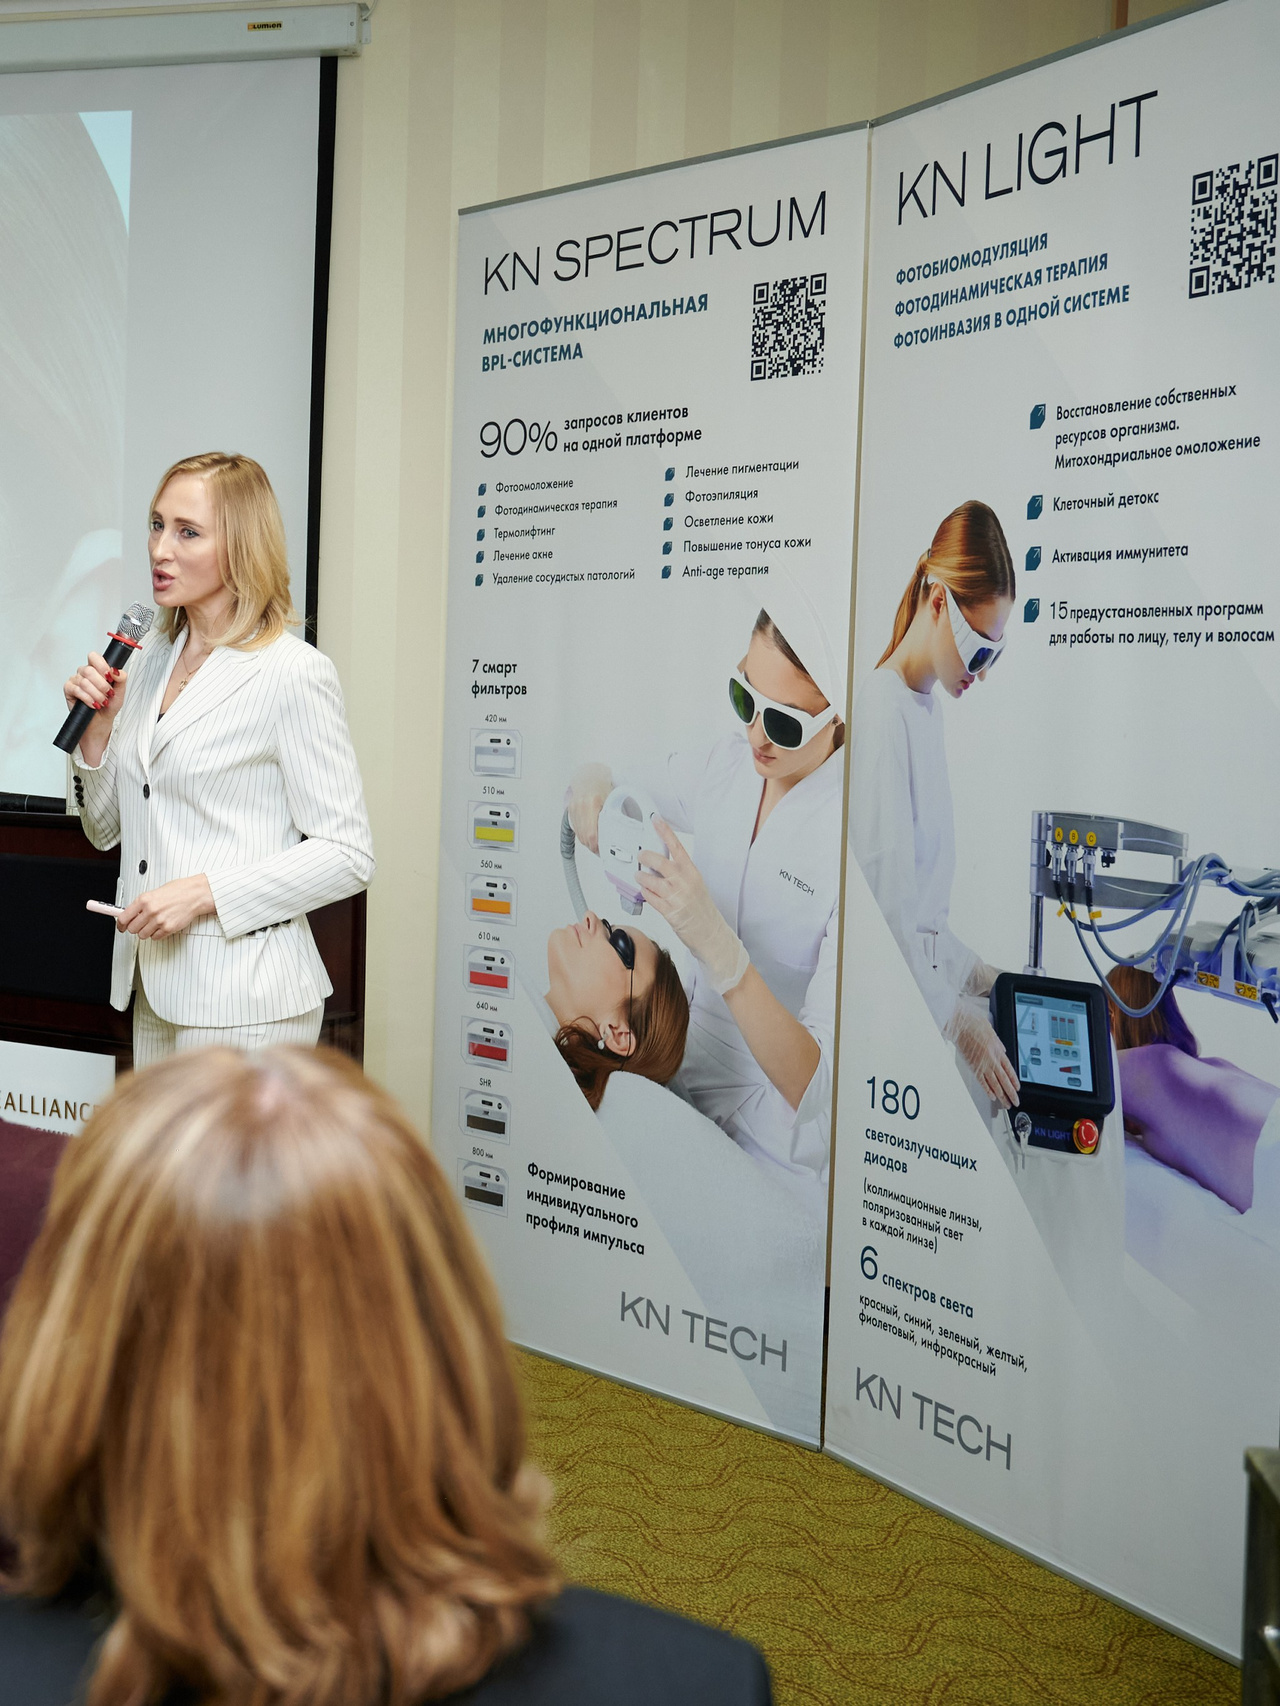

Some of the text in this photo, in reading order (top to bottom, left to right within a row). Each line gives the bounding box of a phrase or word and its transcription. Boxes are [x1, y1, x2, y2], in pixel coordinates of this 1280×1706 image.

[897, 89, 1158, 226] KN LIGHT
[484, 190, 827, 296] KN SPECTRUM
[895, 232, 1048, 285] ФОТОБИОМОДУЛЯЦИЯ
[894, 252, 1108, 318] ФОТОДИНАМИЧЕСКАЯ ТЕРАПИЯ
[483, 293, 709, 345] МНОГОФУНКЦИОНАЛЬНАЯ
[893, 284, 1130, 349] ФОТОИНВАЗИЯ В ОДНОЙ СИСТЕМЕ
[1056, 384, 1237, 421] Восстановление собственных
[563, 405, 689, 433] запросов клиентов
[479, 418, 558, 458] 90%
[563, 426, 703, 453] на одной платформе
[1055, 418, 1180, 449] ресурсов организма.
[1054, 434, 1261, 470] Митохондриальное омоложение
[685, 459, 800, 479] Лечение пигментации
[495, 478, 574, 494] Фотоомоложение
[684, 487, 759, 503] Фотоэпиляция
[494, 498, 618, 517] Фотодинамическая терапия
[1053, 491, 1160, 512] Клеточный детокс
[493, 525, 555, 541] Термолифтинг
[683, 512, 774, 529] Осветление кожи
[492, 549, 553, 562] Лечение акне
[682, 536, 812, 553] Повышение тонуса кожи
[1051, 543, 1189, 564] Активация иммунитета
[492, 568, 636, 586] Удаление сосудистых патологий
[682, 563, 769, 580] Anti-age терапия
[1050, 601, 1264, 623] 15 предустановленных программ
[1049, 627, 1275, 648] для работы по лицу, телу и волосам
[471, 659, 518, 678] 7 смарт
[471, 680, 527, 699] фильтров
[484, 714, 497, 723] 420
[482, 786, 495, 795] 510
[480, 860, 493, 869] 560
[779, 868, 815, 896] KN TECH
[478, 931, 491, 941] 610
[476, 1001, 489, 1011] 640
[479, 1077, 492, 1088] SHR
[866, 1075, 921, 1121] 180
[1034, 1127, 1070, 1141] KN LIGHT
[472, 1147, 484, 1157] 800
[863, 1150, 908, 1174] диодов
[865, 1127, 978, 1172] светоизлучающих
[527, 1162, 626, 1201] Формирование
[526, 1188, 639, 1229] индивидуального
[863, 1176, 982, 1232] (коллимационные линзы,
[525, 1211, 645, 1255] профиля импульса
[862, 1199, 964, 1242] поляризованный свет
[862, 1215, 938, 1254] в каждой линзе)
[860, 1245, 974, 1318] 6 спектров света
[620, 1291, 787, 1372] KN TECH
[858, 1310, 997, 1377] фиолетовый, инфракрасный
[859, 1294, 1028, 1373] красный, синий, зеленый, желтый,
[855, 1366, 1012, 1471] KN TECH
